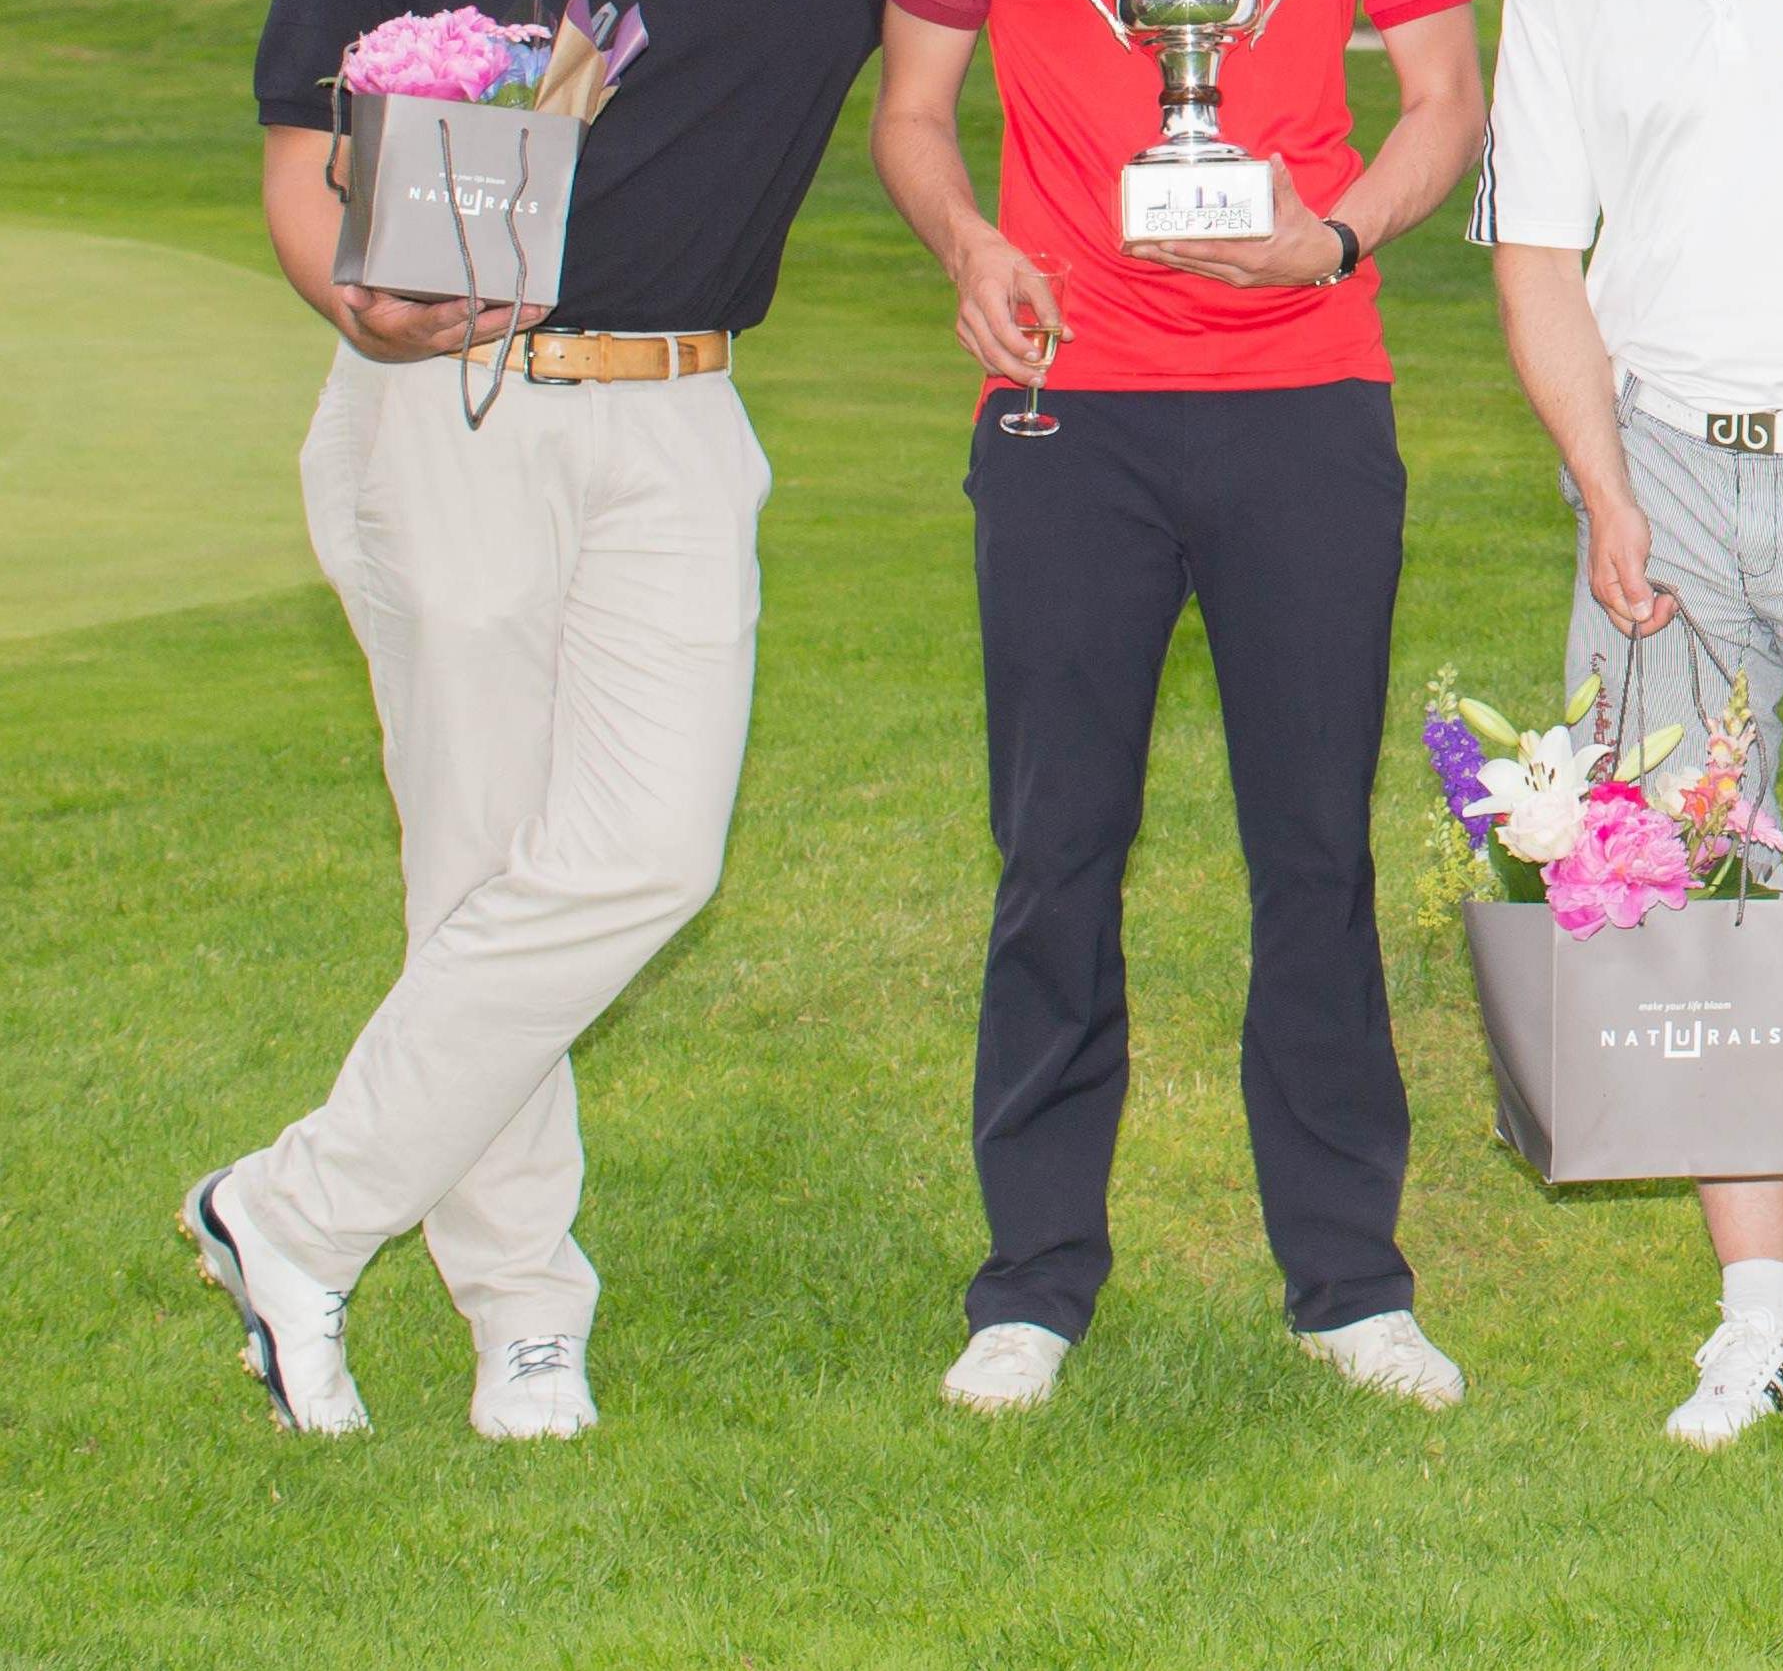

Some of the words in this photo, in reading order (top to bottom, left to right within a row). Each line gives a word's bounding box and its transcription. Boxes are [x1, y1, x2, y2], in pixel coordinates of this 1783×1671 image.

[409, 186, 539, 215] NATURALS
[1145, 218, 1197, 231] GOLF
[1600, 1022, 1782, 1056] NATURALS
